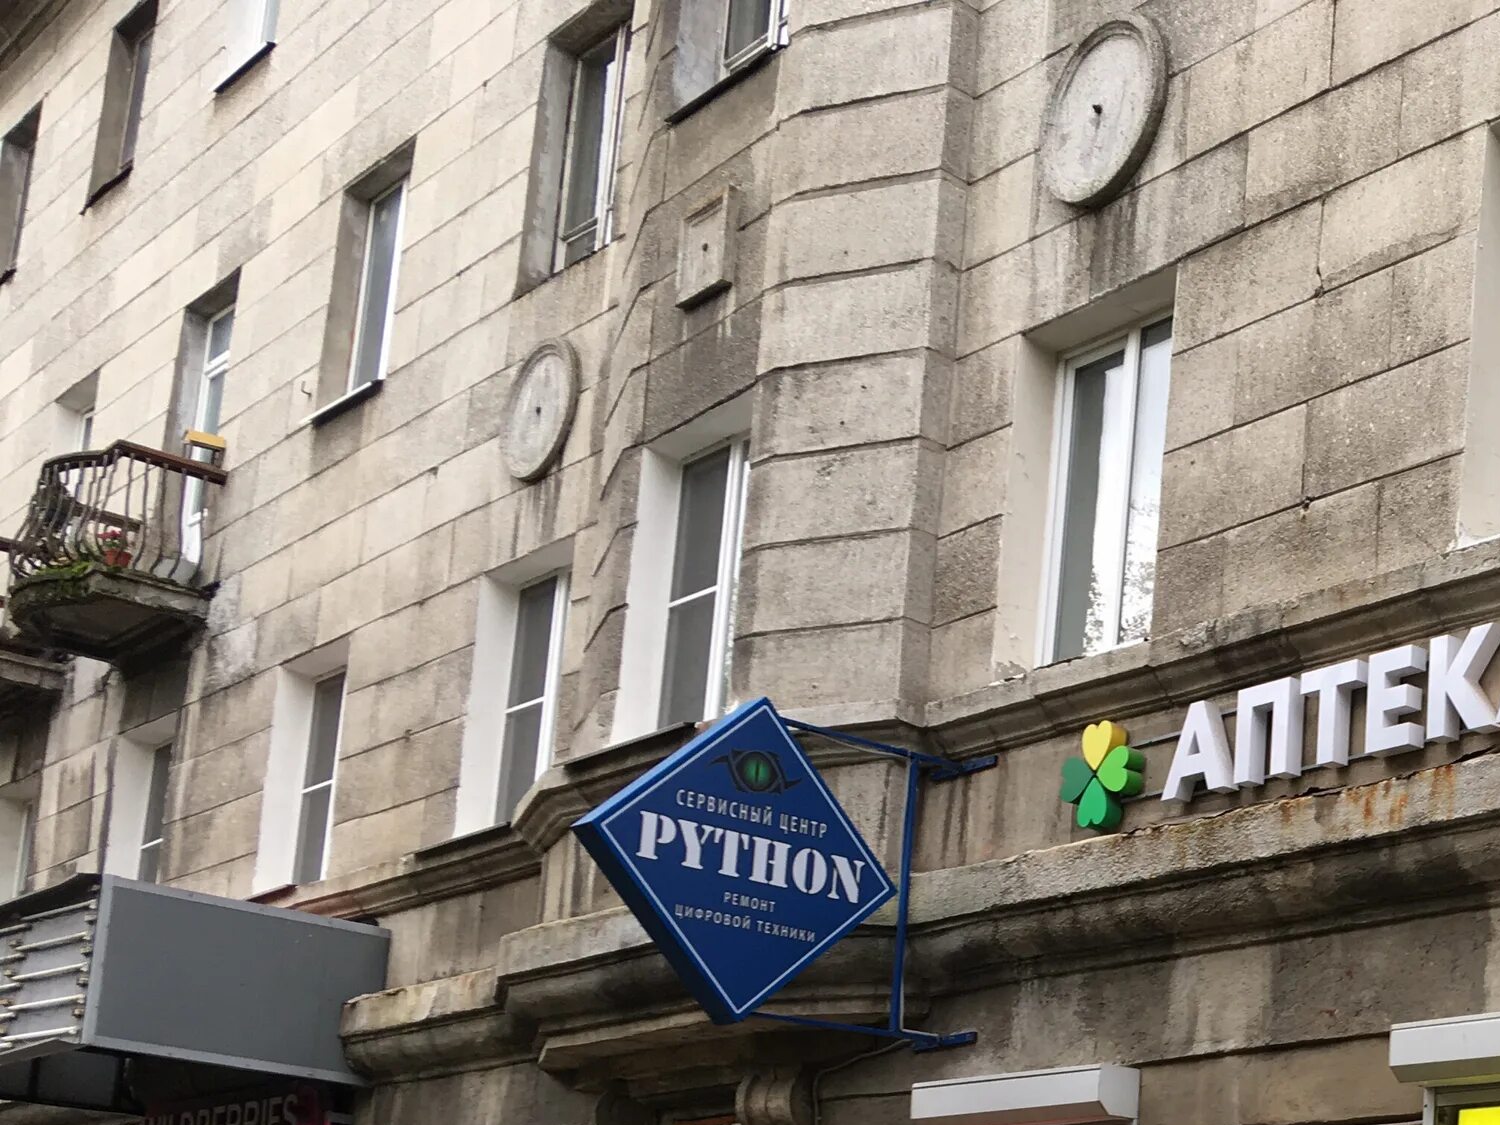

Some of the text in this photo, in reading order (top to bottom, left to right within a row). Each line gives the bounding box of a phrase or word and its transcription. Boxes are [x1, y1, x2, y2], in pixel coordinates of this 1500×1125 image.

[675, 789, 828, 838] СЕРВИСНЫЙ ЦЕНТР
[635, 811, 866, 904] PYTHON
[675, 903, 816, 943] ЦИФРОВОЙ ТЕХНИКИ
[723, 891, 776, 913] РЕМОНТ
